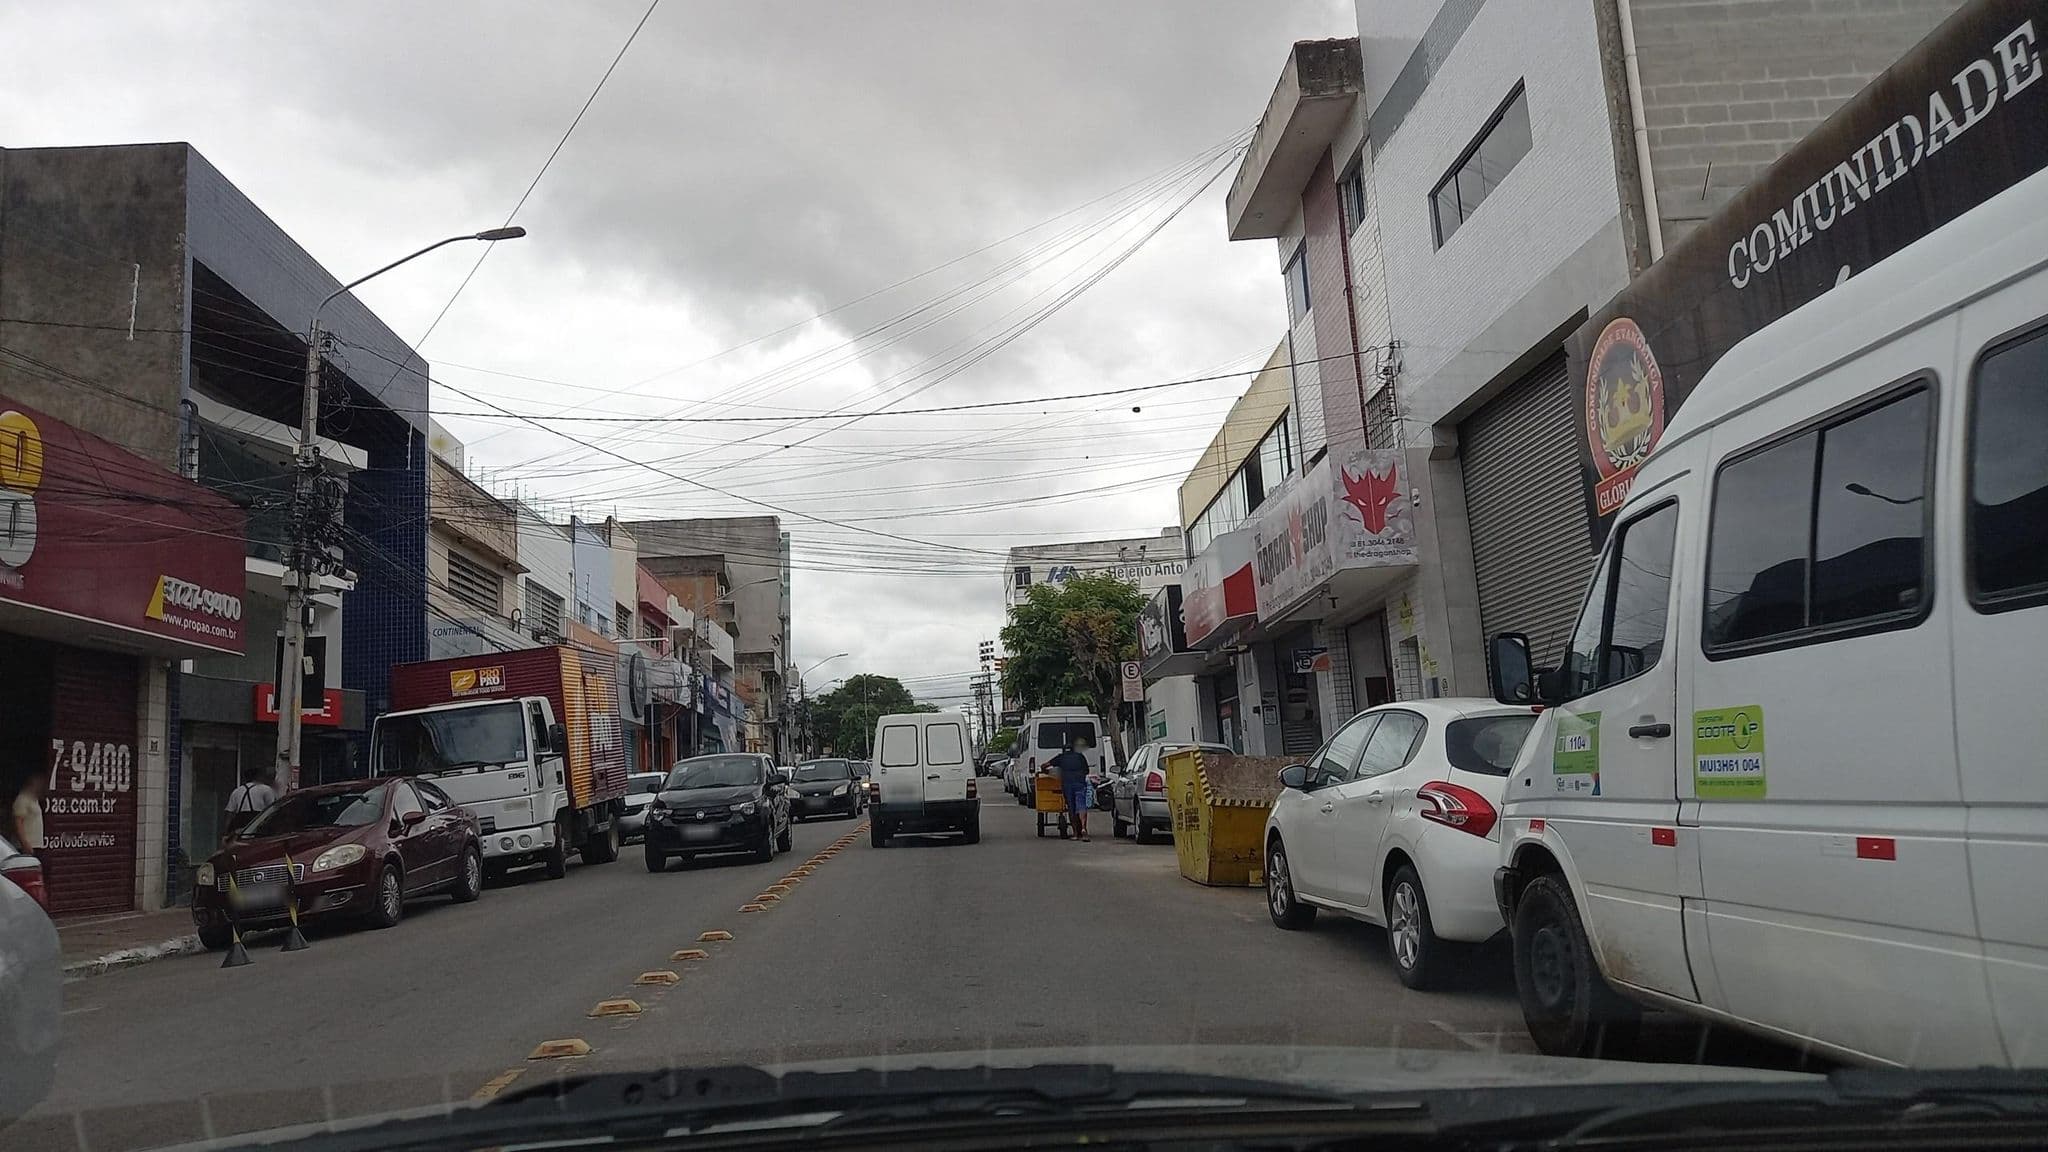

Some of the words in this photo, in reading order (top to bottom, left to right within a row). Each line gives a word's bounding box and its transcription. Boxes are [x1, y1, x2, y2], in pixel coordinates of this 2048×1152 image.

[1728, 20, 2043, 290] COMUNIDADE
[1600, 477, 1634, 510] GLÓRI
[1257, 528, 1292, 587] DRAGON
[1301, 495, 1328, 555] SHOP
[162, 612, 237, 640] www.propao.com.br
[480, 668, 500, 678] PRO
[1128, 666, 1135, 676] E
[1700, 759, 1739, 772] MUI3H61
[1742, 758, 1760, 772] 004
